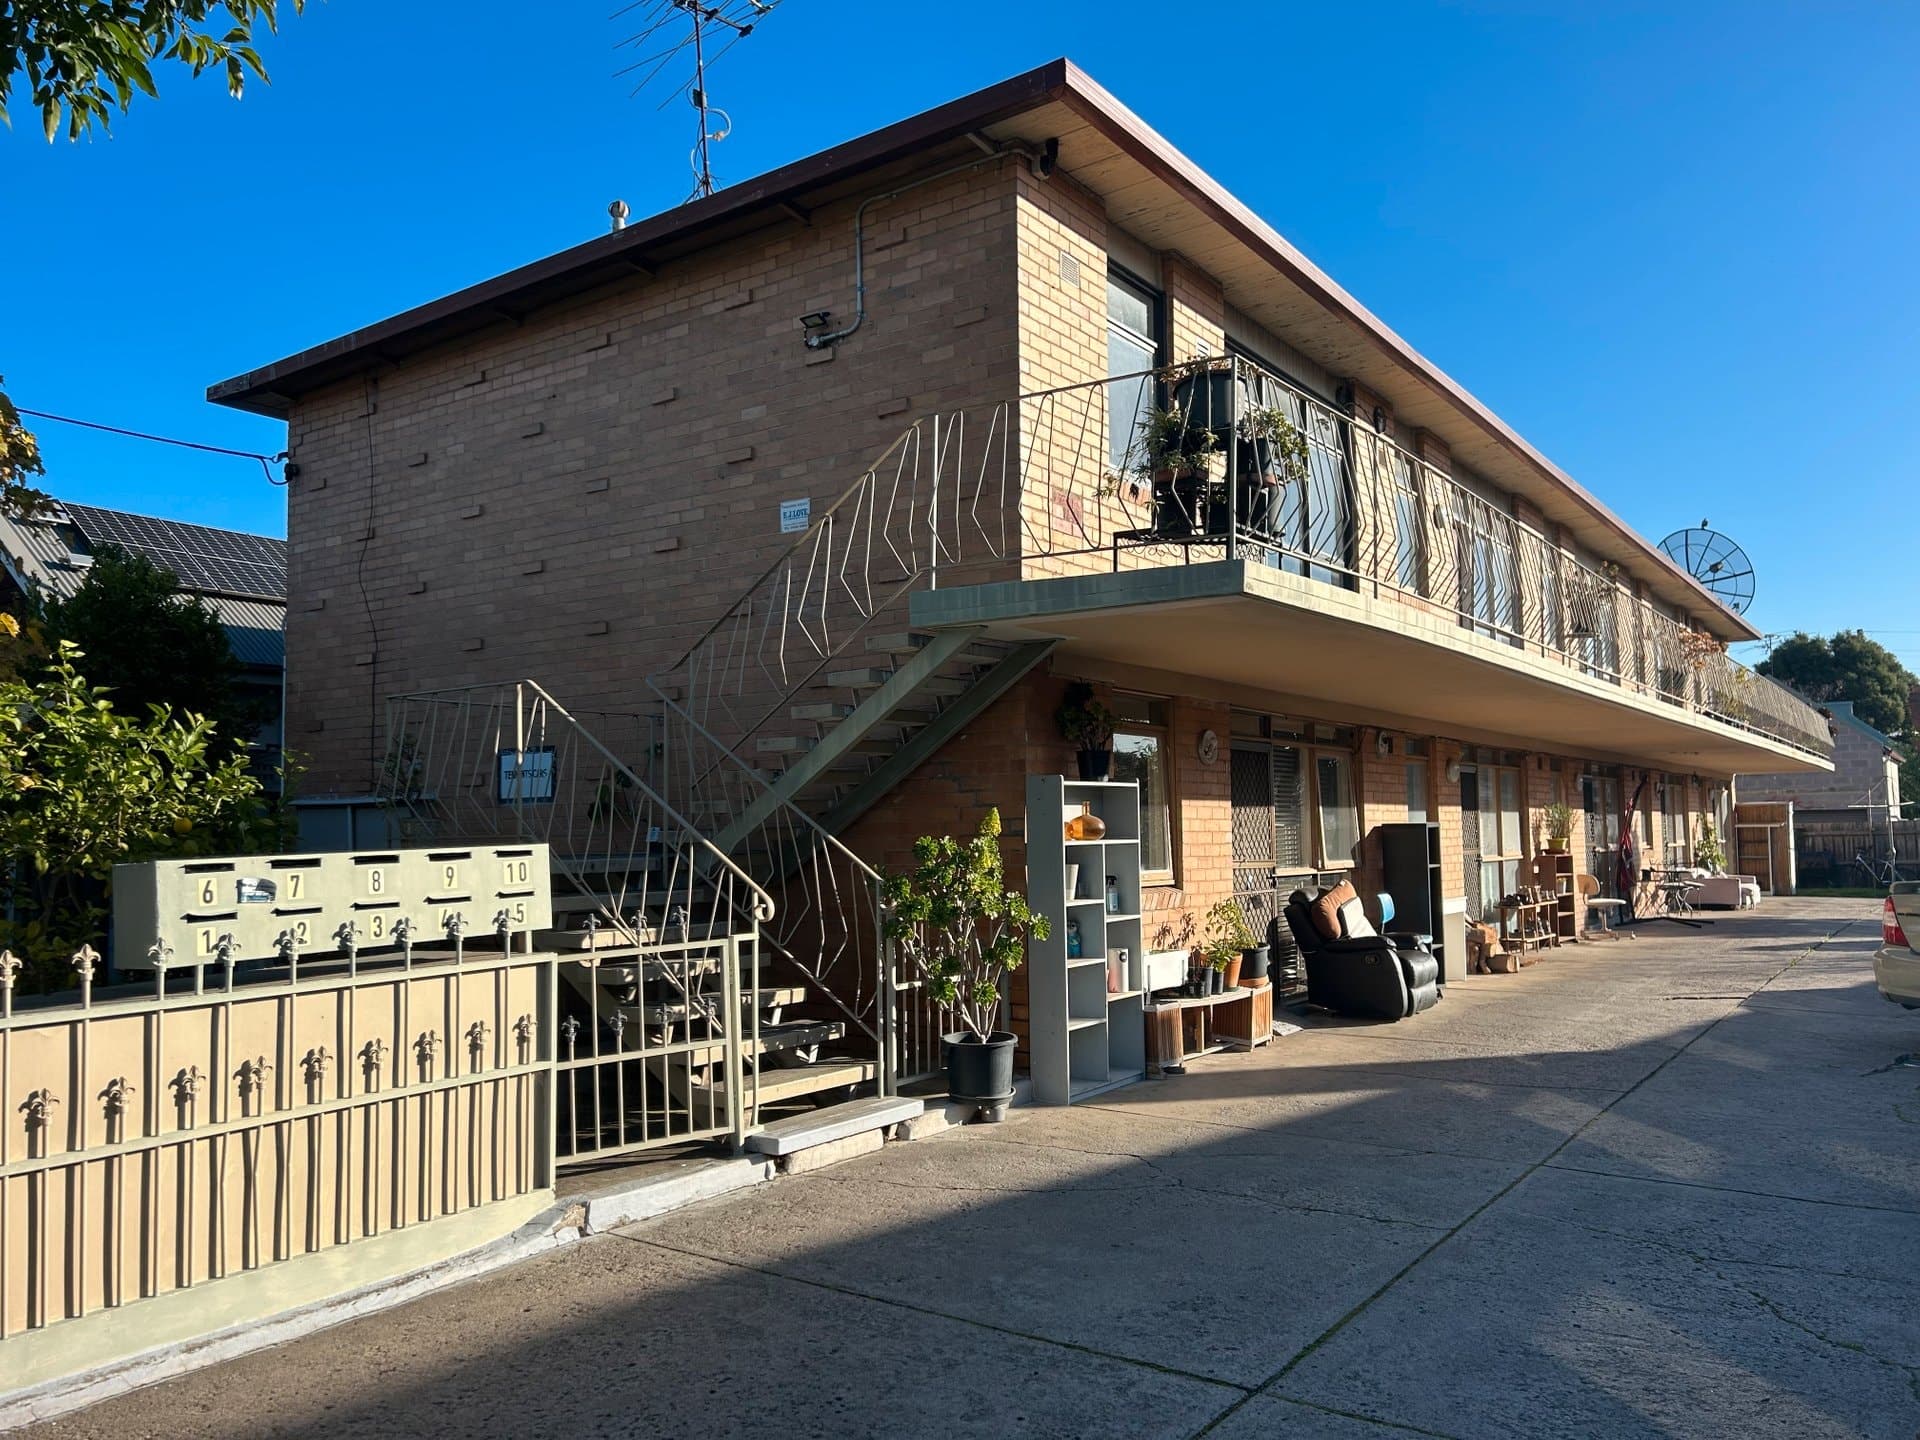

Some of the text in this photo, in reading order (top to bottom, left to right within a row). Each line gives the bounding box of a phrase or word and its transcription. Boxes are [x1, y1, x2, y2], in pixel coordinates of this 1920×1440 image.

[372, 870, 381, 892] 8
[446, 866, 454, 887] 9
[507, 862, 527, 883] 10
[202, 879, 214, 904] 6
[290, 874, 300, 898] 7
[516, 903, 524, 923] 5
[297, 921, 308, 944] 2
[373, 916, 383, 938] 3
[202, 929, 211, 953] 1
